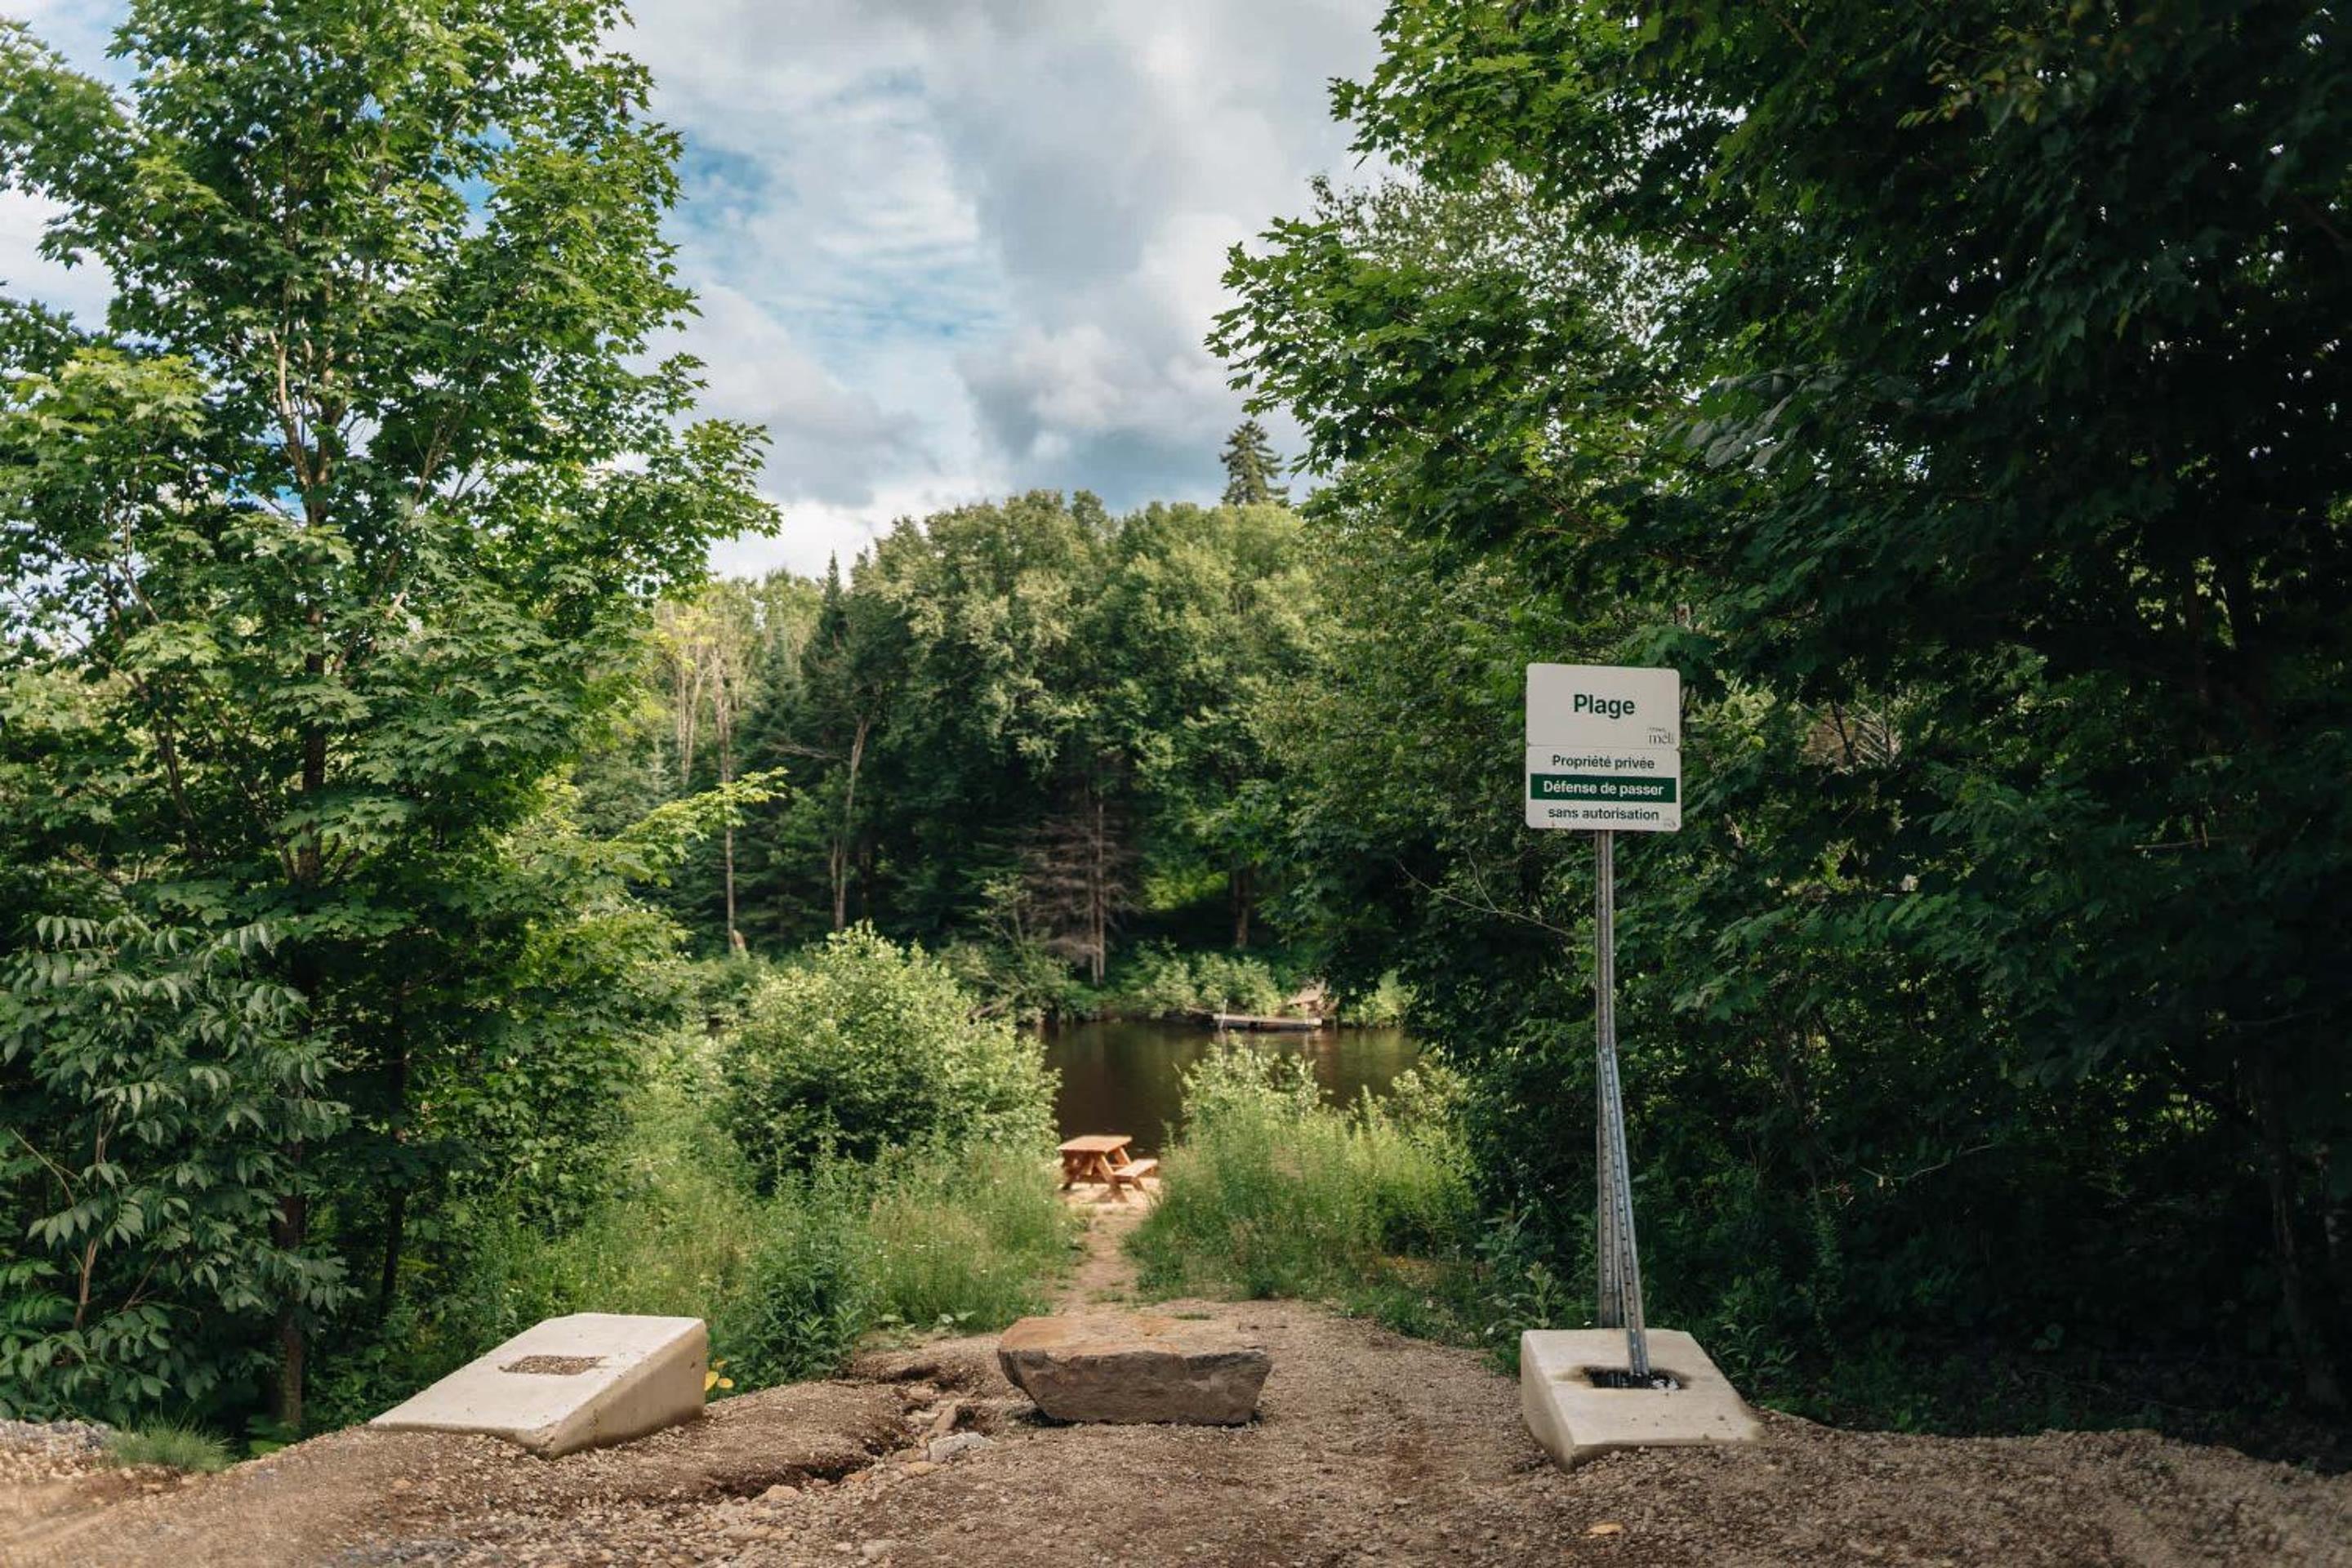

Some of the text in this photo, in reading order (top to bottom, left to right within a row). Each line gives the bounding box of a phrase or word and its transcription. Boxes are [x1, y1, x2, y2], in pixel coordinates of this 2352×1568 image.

[1574, 694, 1635, 719] Plage
[1552, 755, 1655, 771] Propriété privée
[1544, 780, 1664, 798] Défense de passer
[1548, 807, 1659, 821] sans autorisation
